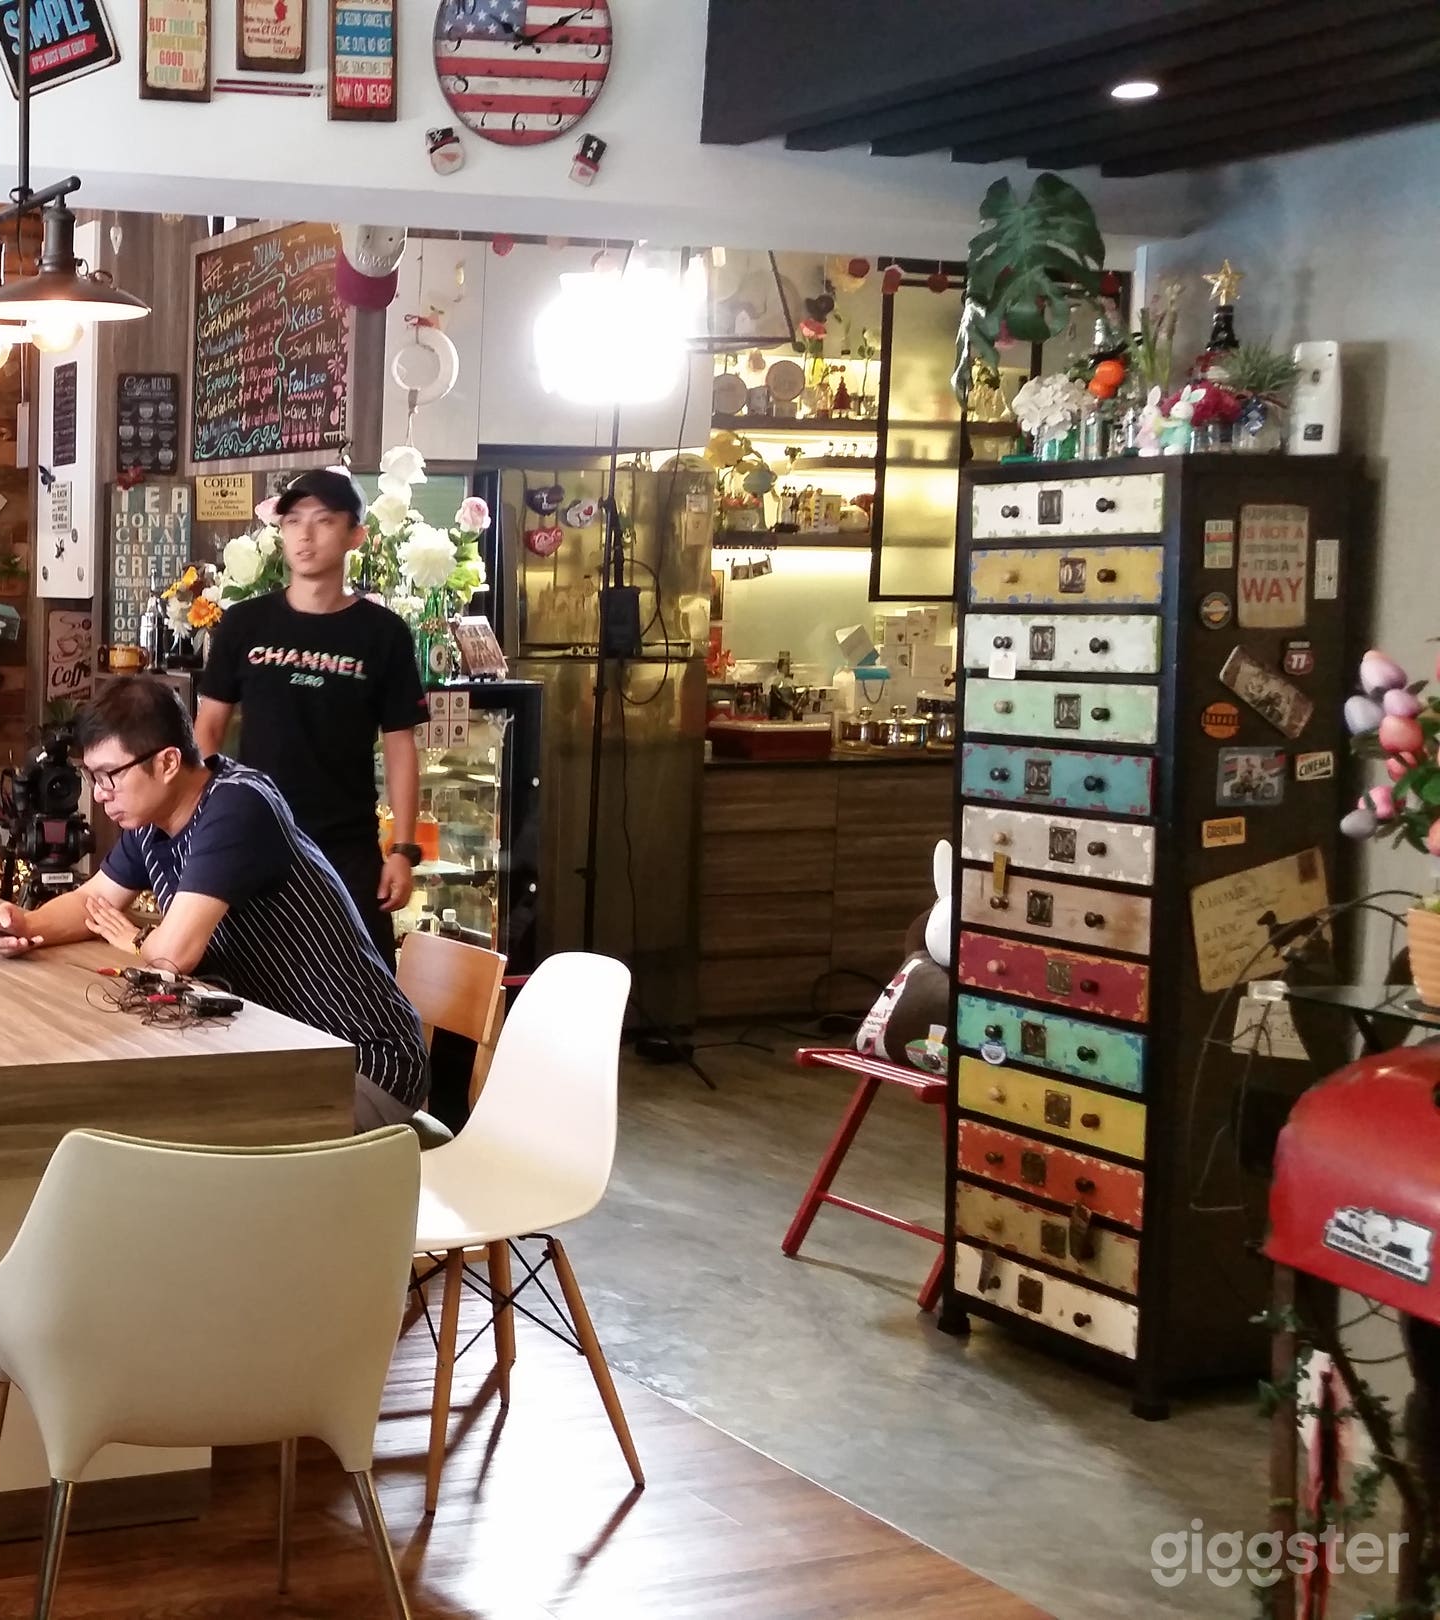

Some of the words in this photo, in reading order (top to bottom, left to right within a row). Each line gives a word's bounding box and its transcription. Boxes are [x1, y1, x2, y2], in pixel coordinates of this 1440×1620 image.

[3, 0, 90, 55] SMPLE
[159, 50, 184, 66] GOOD
[203, 477, 246, 489] COFFEE
[117, 486, 188, 513] TEA
[115, 512, 187, 528] HONEY
[115, 528, 187, 543] CHAI
[115, 544, 148, 555] EARL
[115, 555, 187, 577] GREEN
[1280, 559, 1290, 571] A
[1241, 577, 1304, 603] WAY
[247, 646, 367, 680] CHANNEL
[289, 672, 325, 688] ZERO
[1298, 756, 1331, 777] CINEMA
